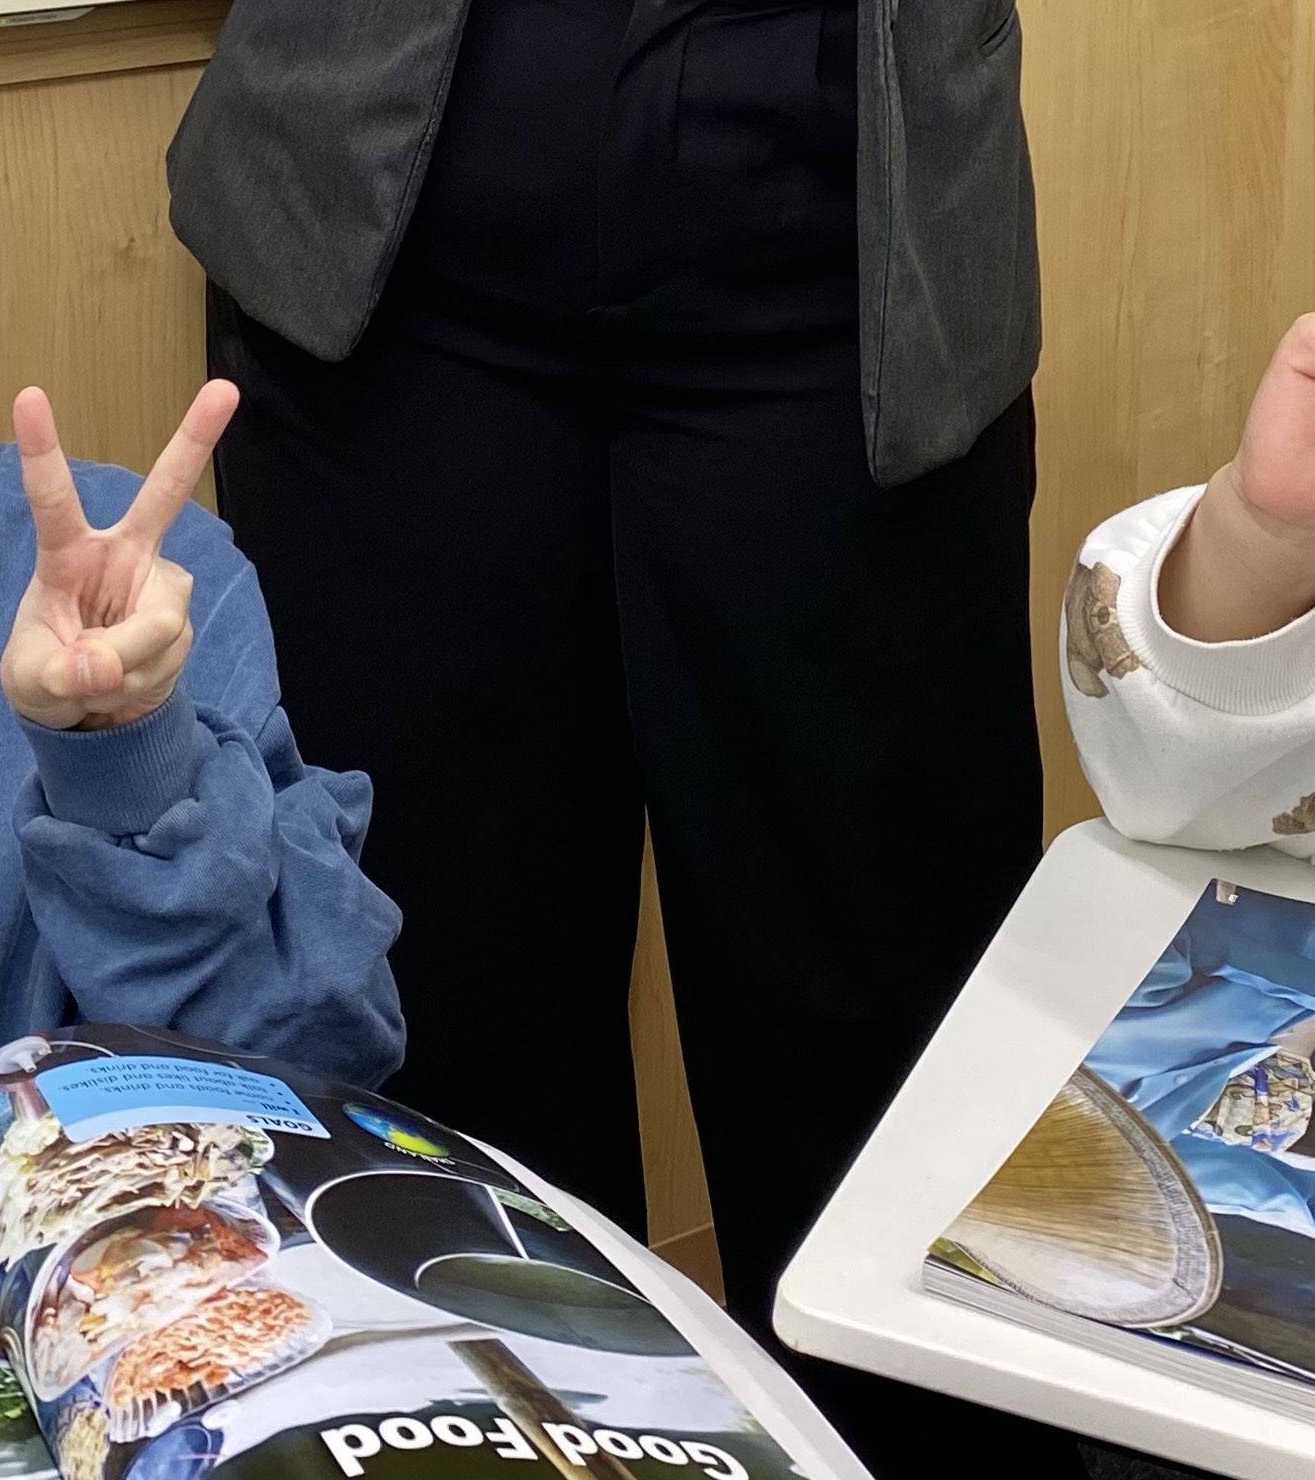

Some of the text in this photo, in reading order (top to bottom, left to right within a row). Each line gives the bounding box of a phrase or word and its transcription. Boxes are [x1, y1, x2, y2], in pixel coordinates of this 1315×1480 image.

[175, 1064, 209, 1075] food
[122, 1073, 153, 1082] and
[156, 1082, 185, 1090] and
[189, 1084, 231, 1095] foods
[246, 1115, 313, 1132] GOALS
[320, 1415, 751, 1480] Good Food
